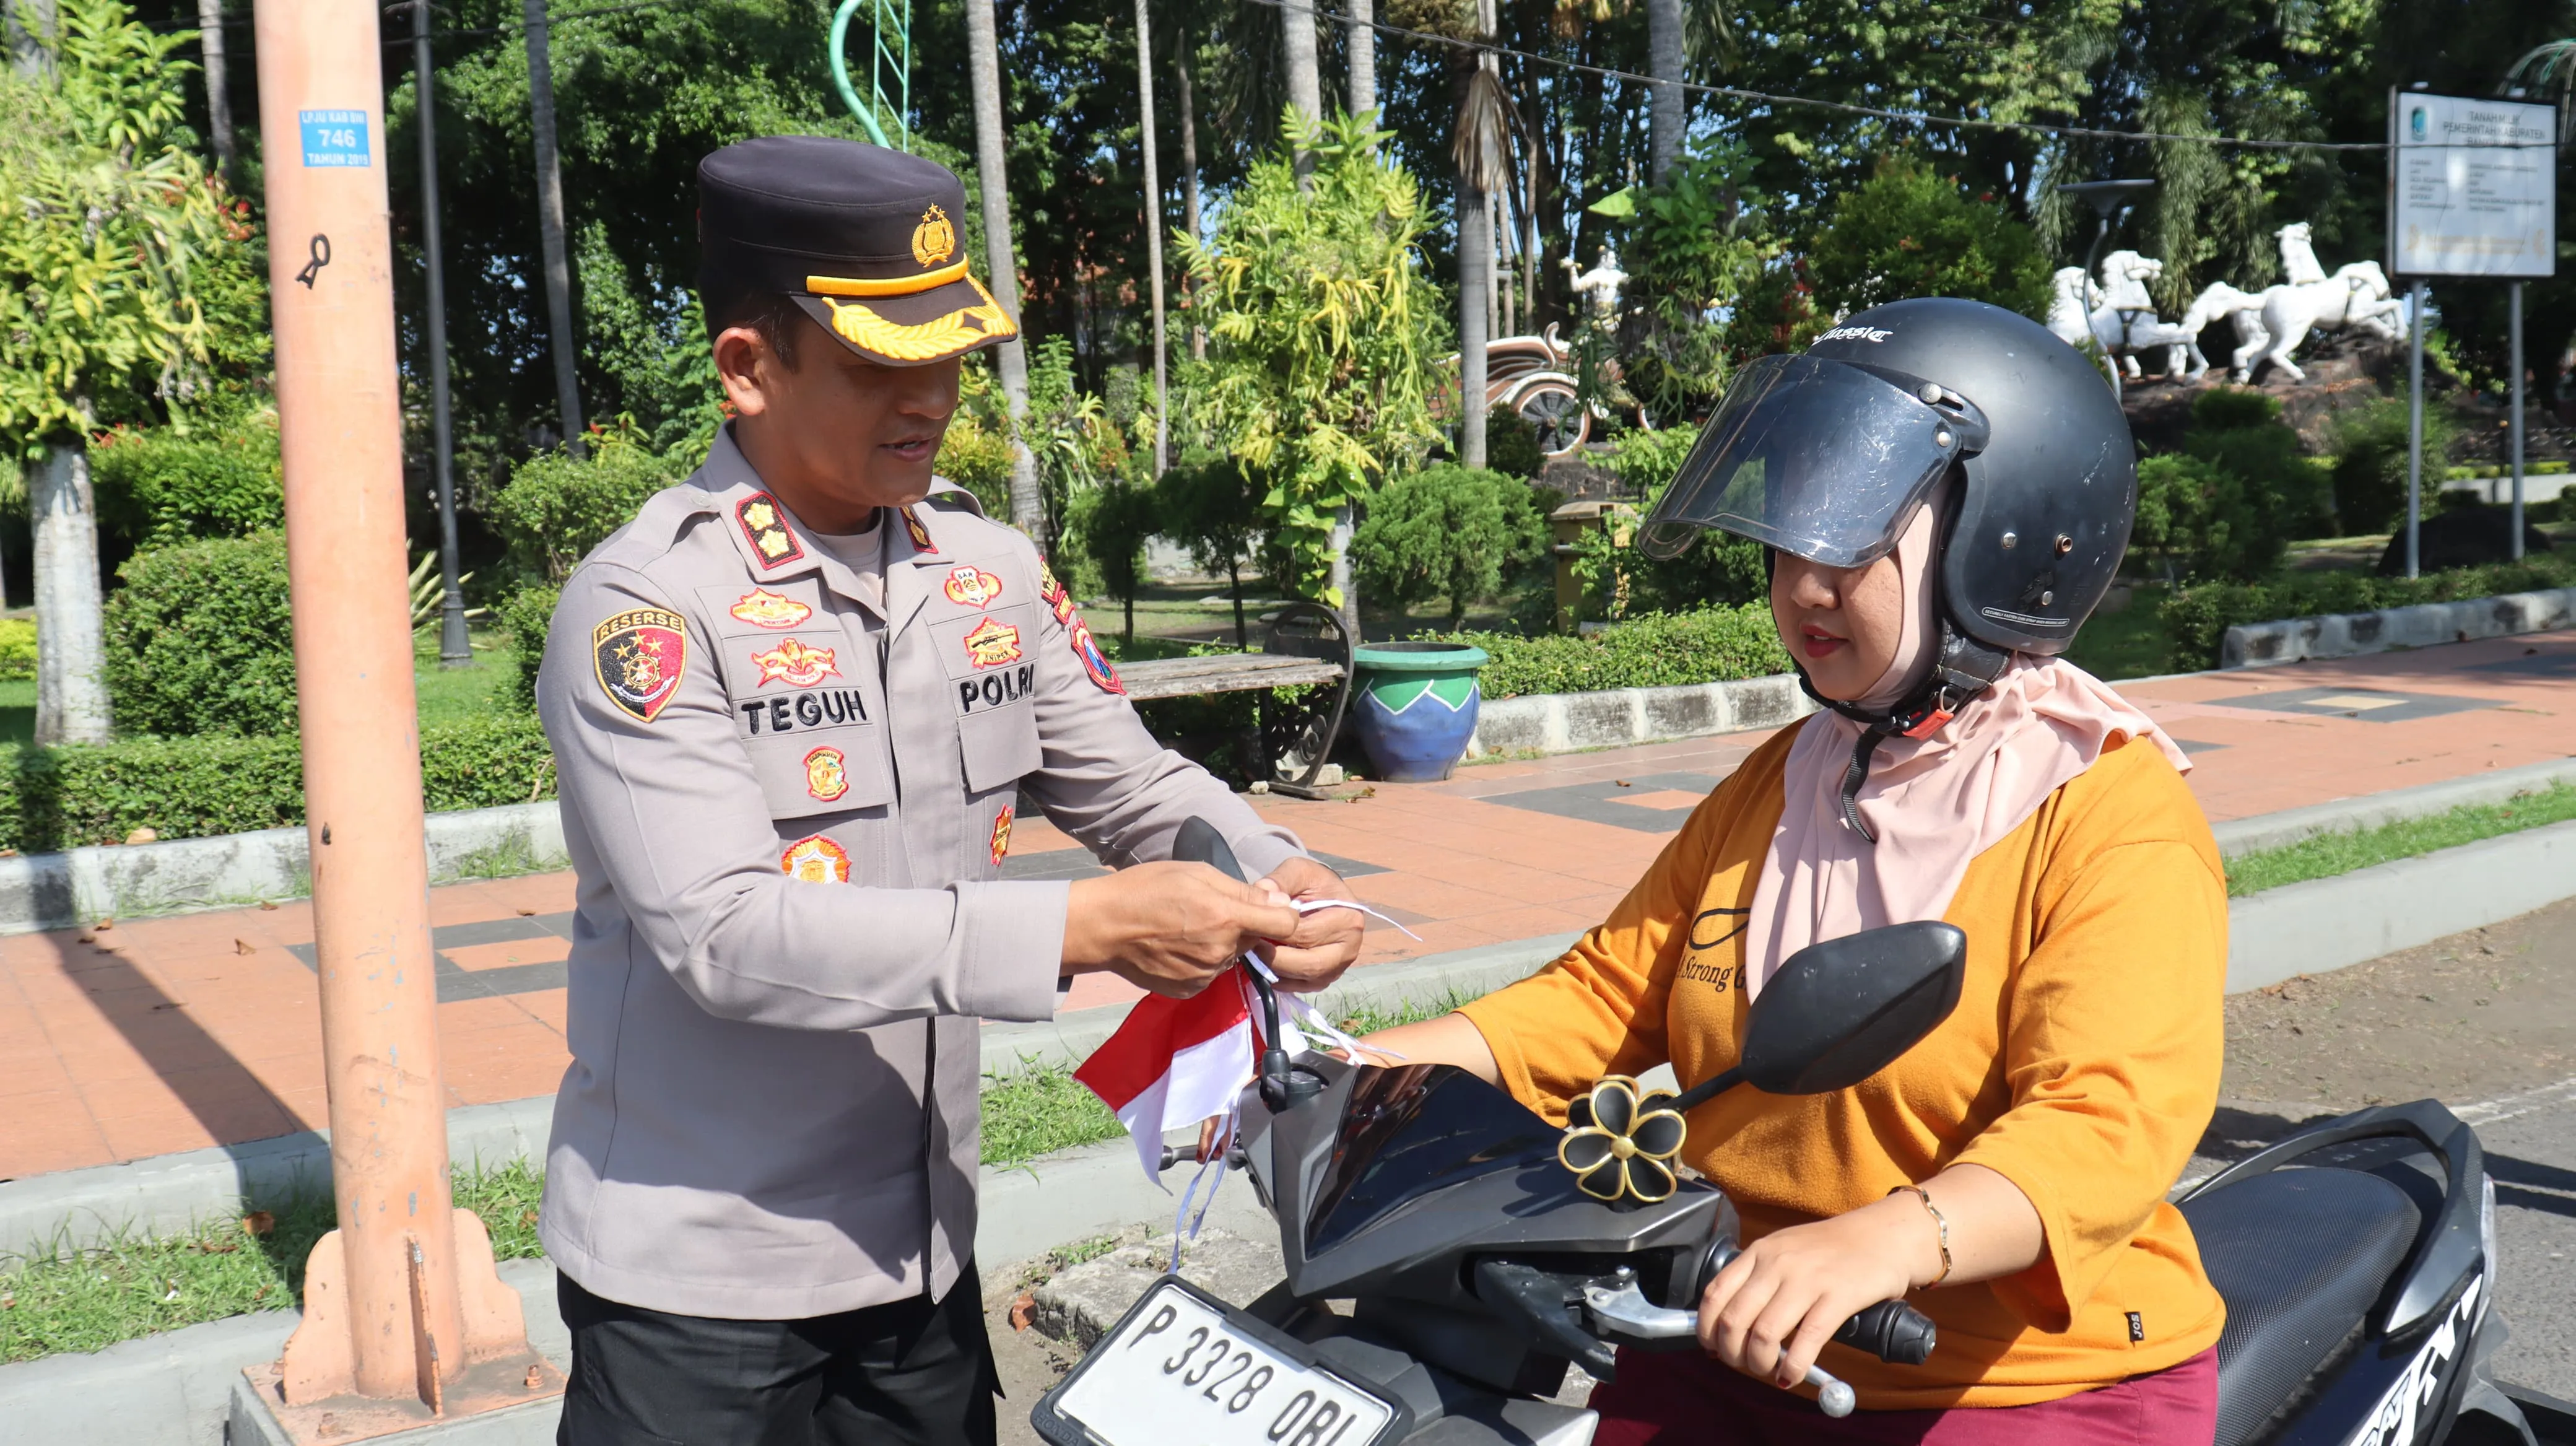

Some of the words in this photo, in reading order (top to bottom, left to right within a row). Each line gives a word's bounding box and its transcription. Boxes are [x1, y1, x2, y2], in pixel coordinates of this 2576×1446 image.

[2443, 121, 2496, 134] PEMERINTAH
[2469, 111, 2497, 122] TANAH
[317, 129, 356, 147] 746
[307, 153, 345, 165] TAHUN
[598, 611, 681, 638] RESERSE
[959, 663, 1034, 712] POLRI
[741, 690, 867, 734] TEGUH
[1681, 956, 1734, 992] Strong
[2131, 1314, 2143, 1338] JOS
[1128, 1304, 1177, 1351] P
[1164, 1326, 1274, 1414] 3328
[1035, 1411, 1080, 1446] HONDA
